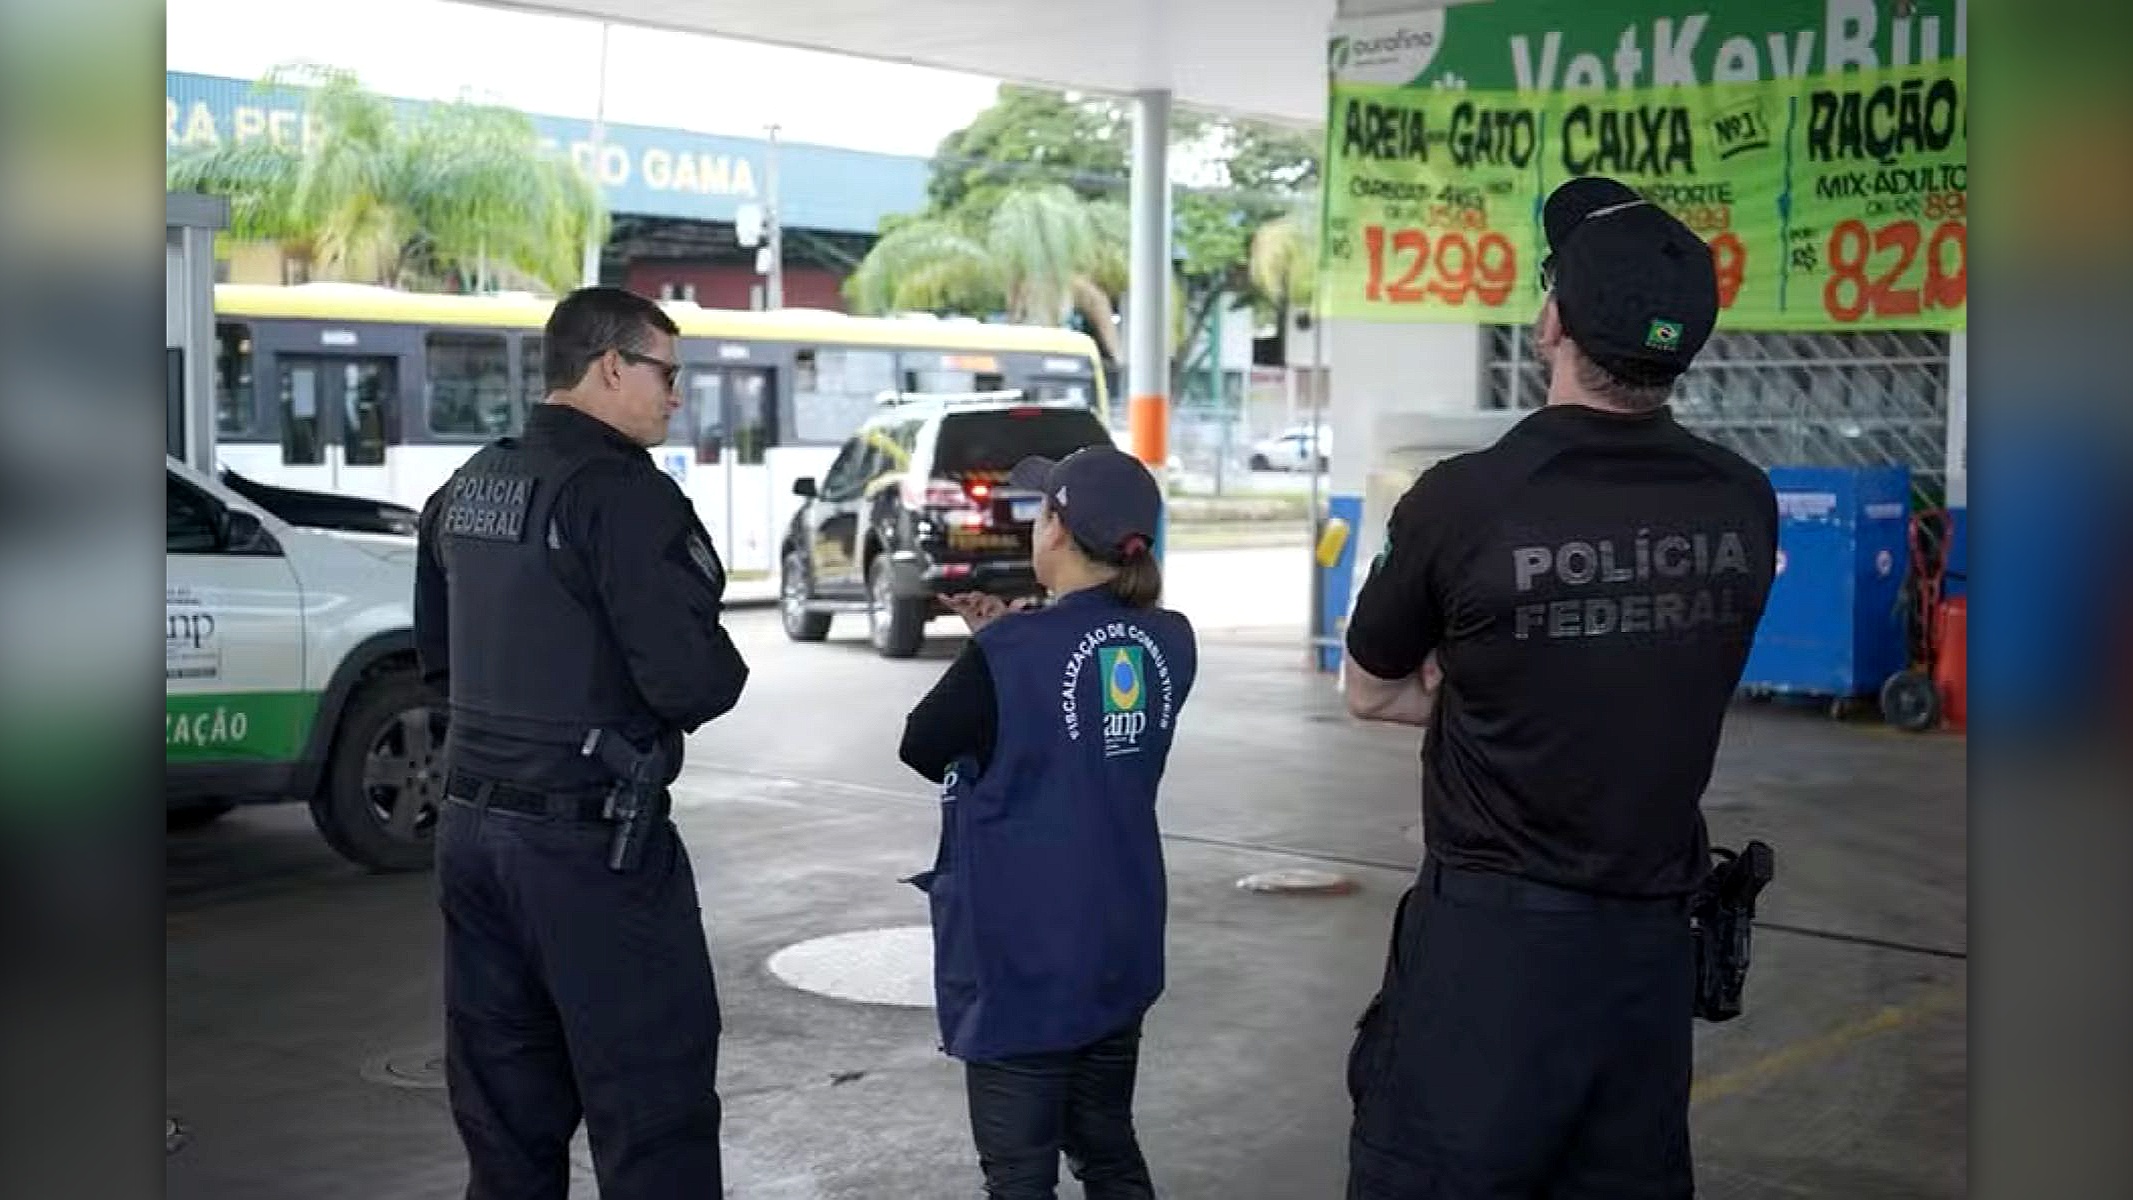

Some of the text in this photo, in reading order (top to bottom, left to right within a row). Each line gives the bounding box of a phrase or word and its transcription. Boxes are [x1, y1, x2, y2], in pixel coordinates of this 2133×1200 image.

[1562, 104, 1697, 176] CAIXA
[1808, 78, 1957, 164] RAÇÃO
[642, 148, 757, 197] GAMA
[1364, 224, 1517, 308] 1299
[444, 506, 522, 536] FEDERAL
[1512, 527, 1750, 590] POLÍCIA
[167, 612, 216, 649] np
[1107, 623, 1126, 639] DE
[1512, 589, 1742, 640] FEDERAL
[1103, 710, 1147, 744] anp
